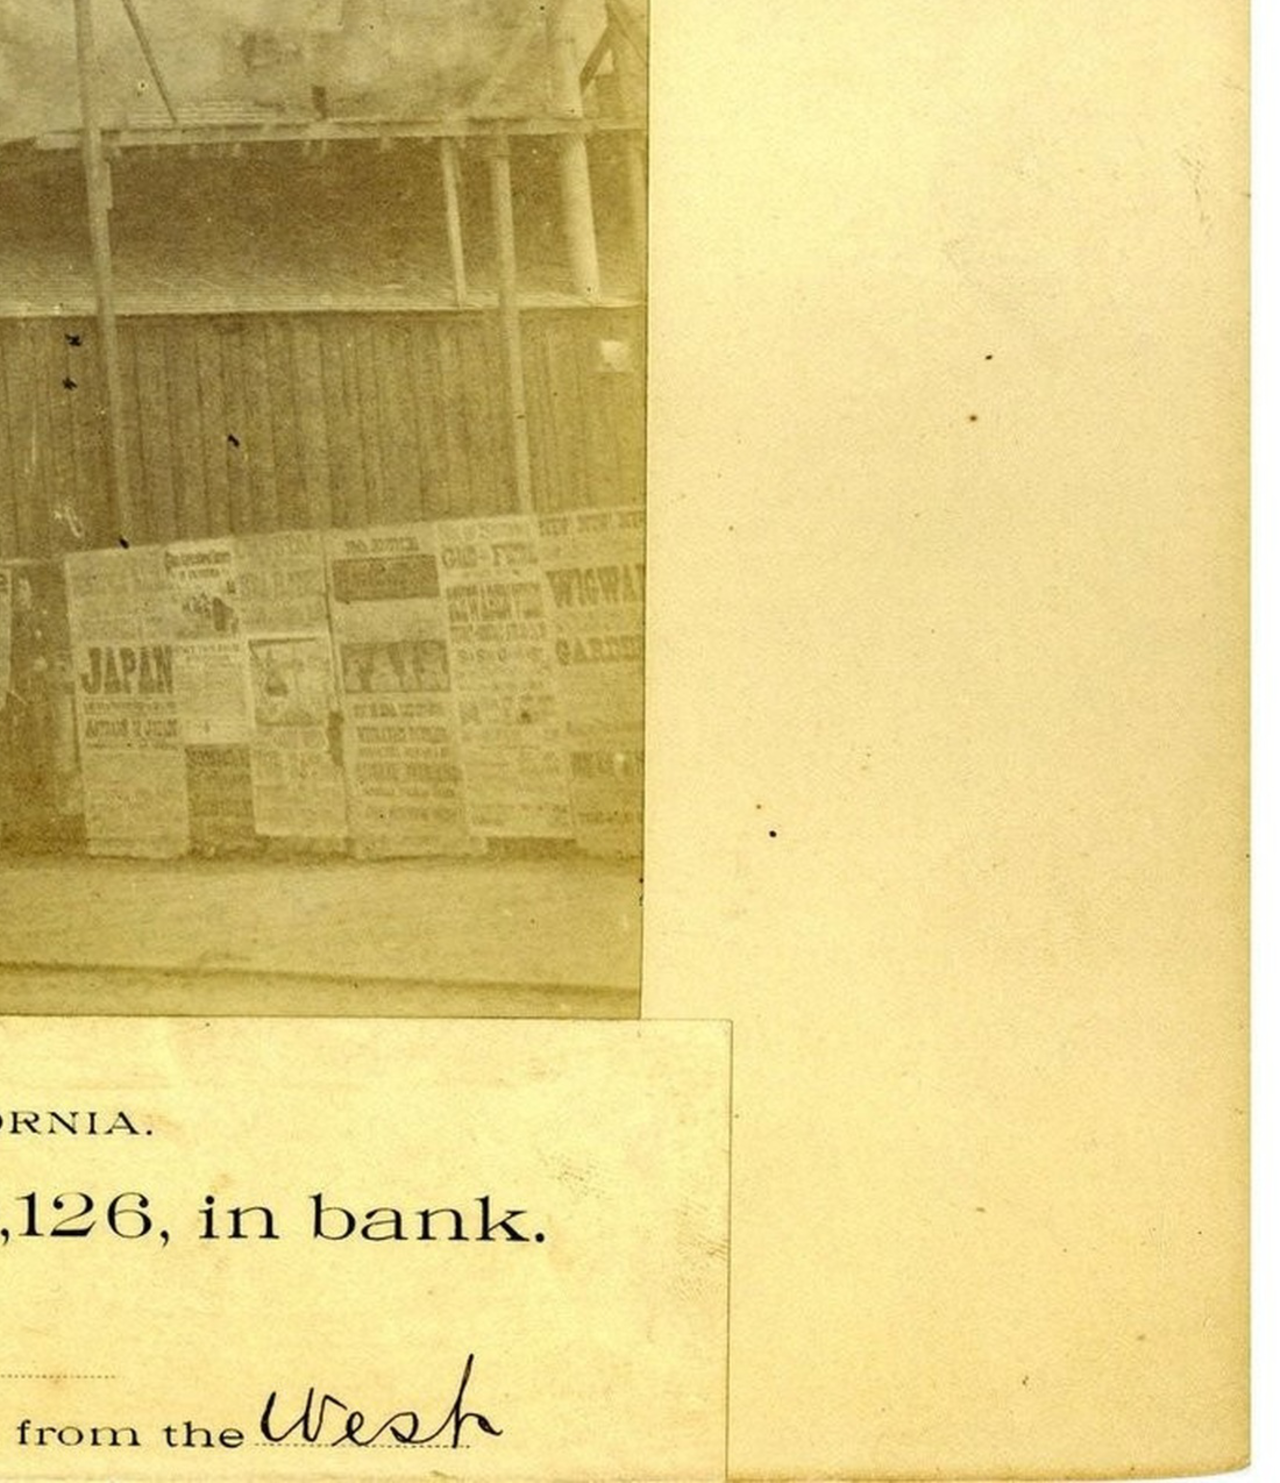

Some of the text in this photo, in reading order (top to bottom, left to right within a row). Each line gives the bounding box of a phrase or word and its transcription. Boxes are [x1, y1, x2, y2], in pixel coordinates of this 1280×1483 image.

[80, 645, 173, 694] JAPAN
[199, 1195, 280, 1239] in
[309, 1192, 545, 1243] bank.
[17, 1419, 141, 1446] from
[162, 1421, 244, 1448] the
[260, 1353, 503, 1449] West
